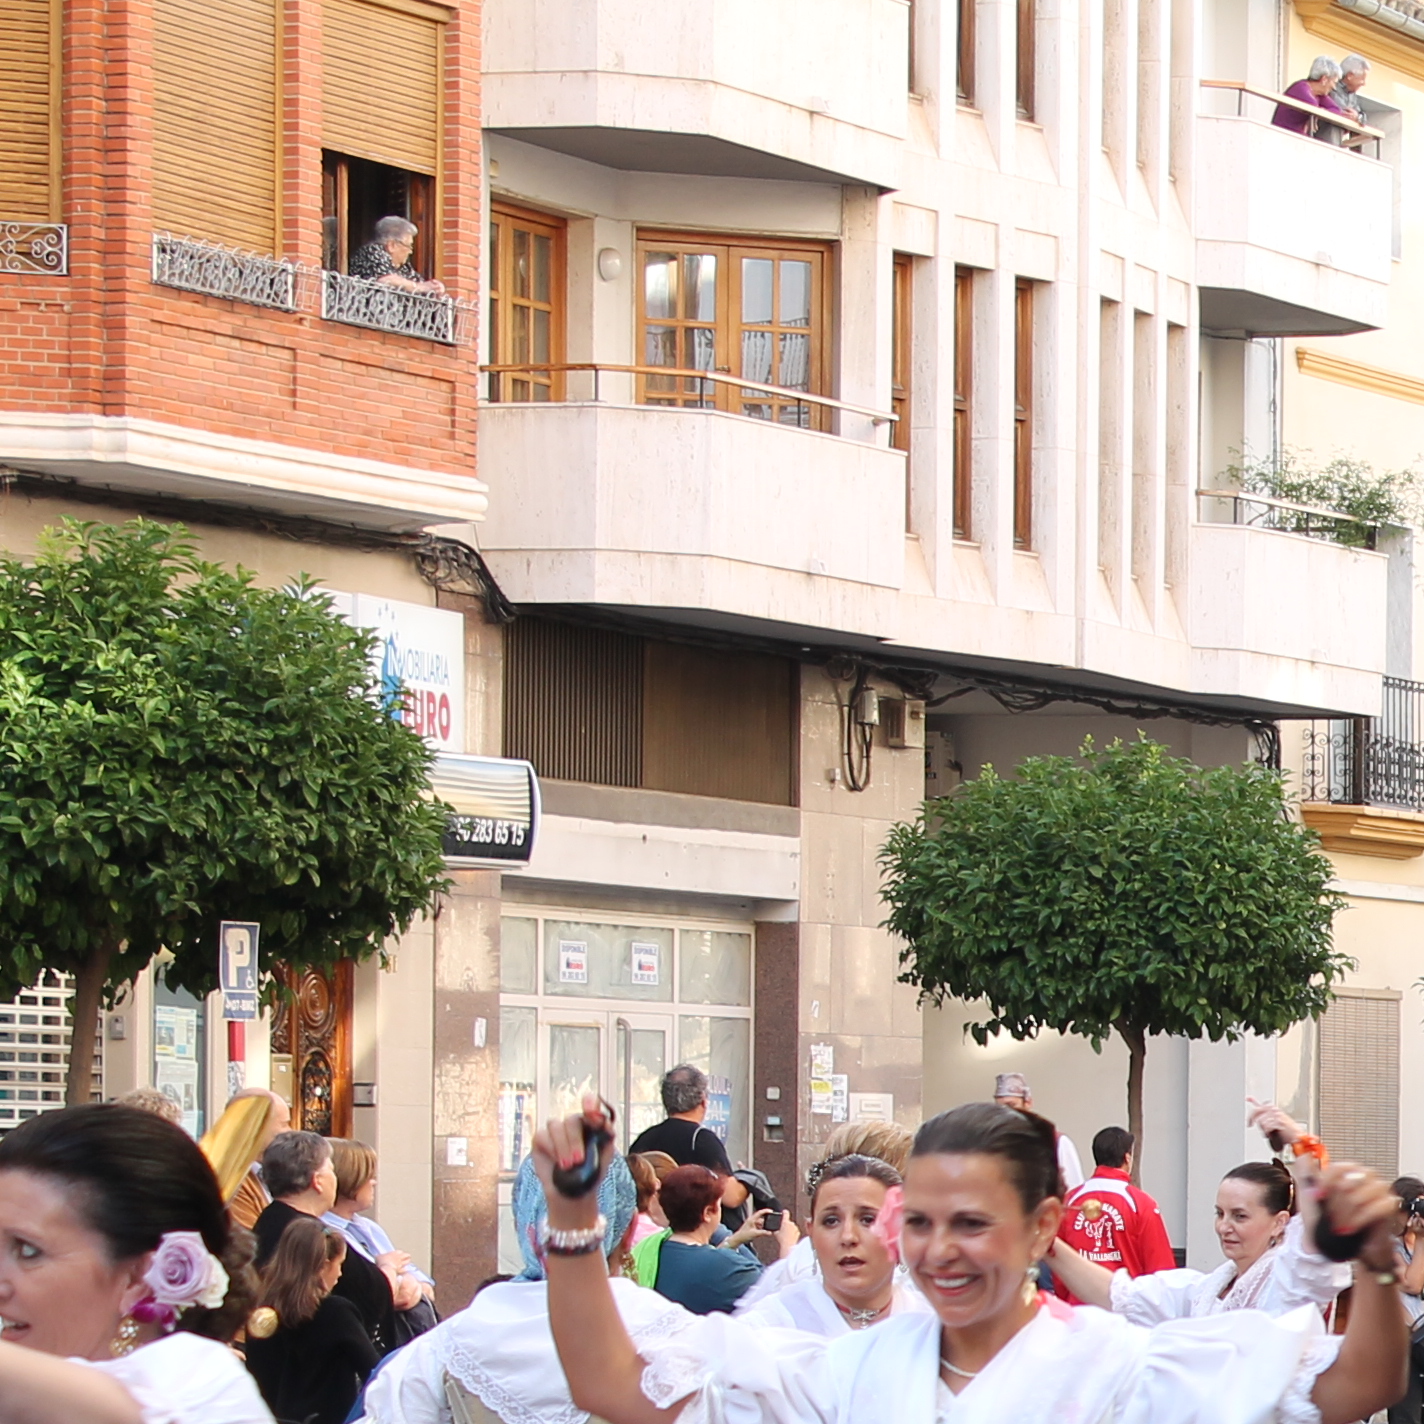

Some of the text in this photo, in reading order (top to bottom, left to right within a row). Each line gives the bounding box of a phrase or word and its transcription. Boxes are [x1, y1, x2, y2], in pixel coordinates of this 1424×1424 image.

[387, 646, 450, 687] INMOBILIARIA
[401, 688, 451, 742] EURO
[472, 818, 493, 844] 283
[494, 820, 509, 846] 65
[511, 823, 525, 847] 15
[224, 927, 251, 988] P
[1102, 1202, 1125, 1231] KARATE
